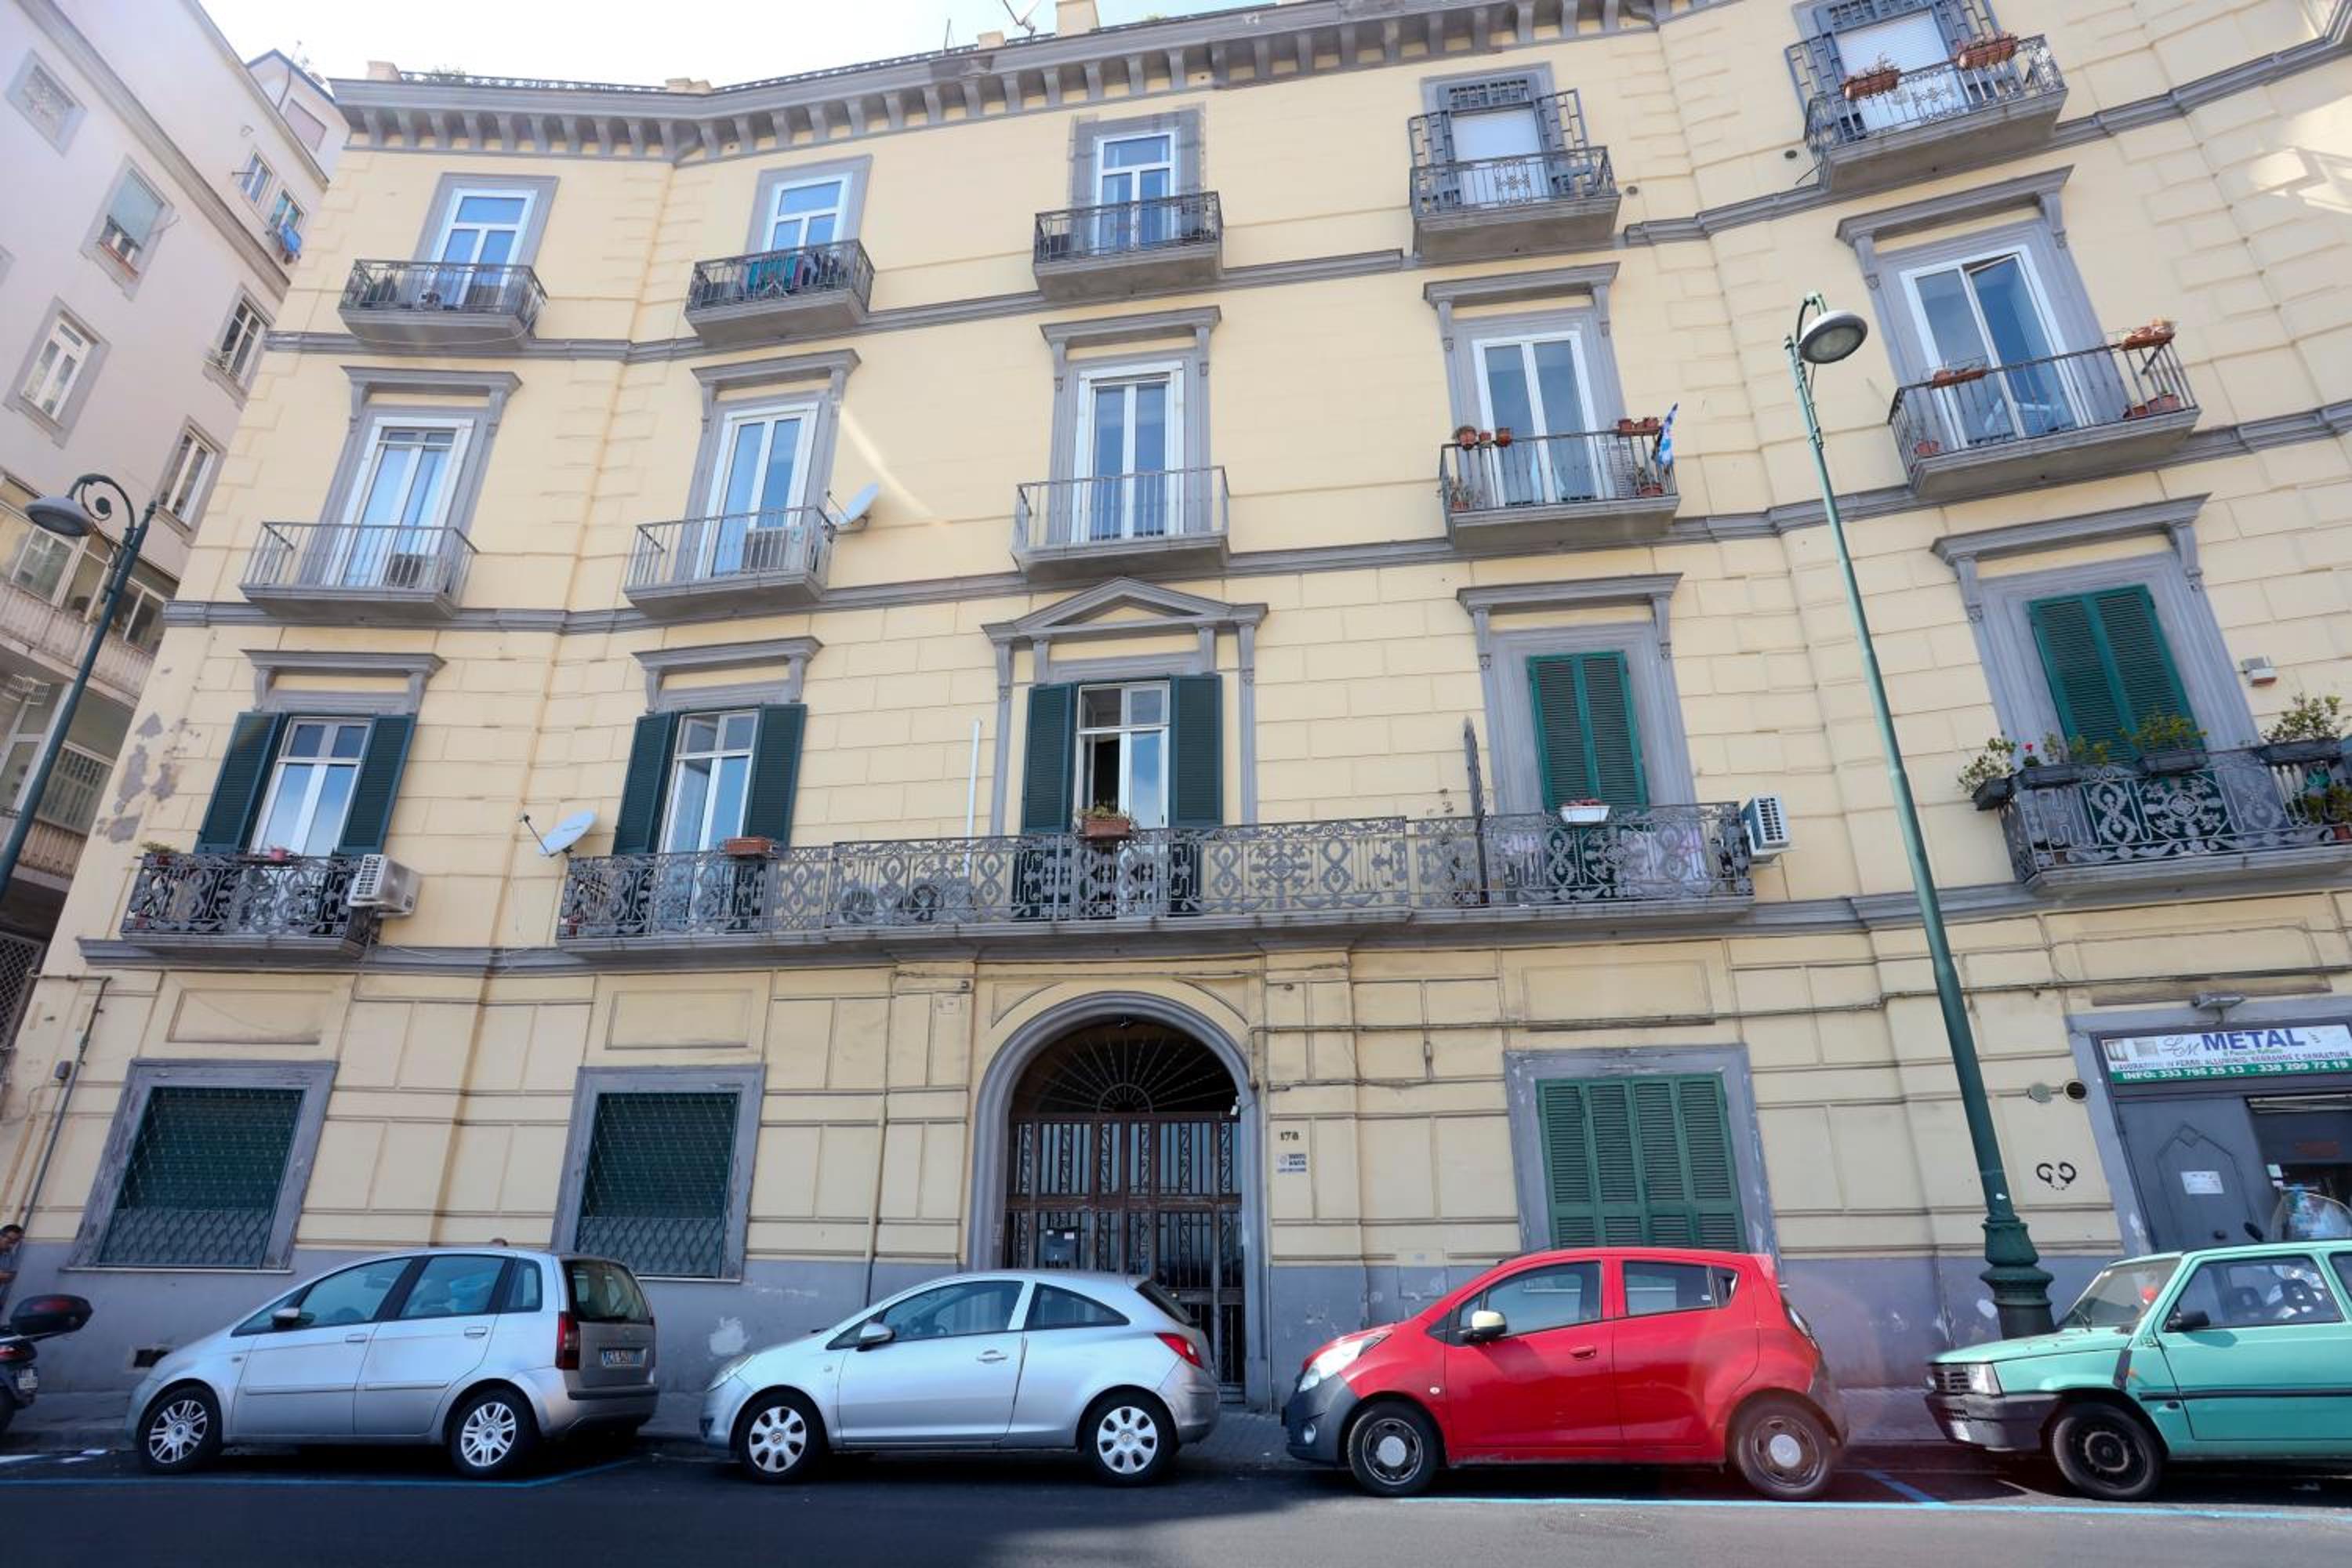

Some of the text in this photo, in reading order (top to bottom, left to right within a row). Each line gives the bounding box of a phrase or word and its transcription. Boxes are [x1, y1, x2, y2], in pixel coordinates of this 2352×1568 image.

[2201, 1029, 2307, 1051] METAL
[2122, 1069, 2157, 1080] INFO:
[2159, 1068, 2183, 1078] 333
[2209, 1065, 2227, 1075] 25
[2230, 1065, 2245, 1074] 13
[2312, 1060, 2330, 1069] 72
